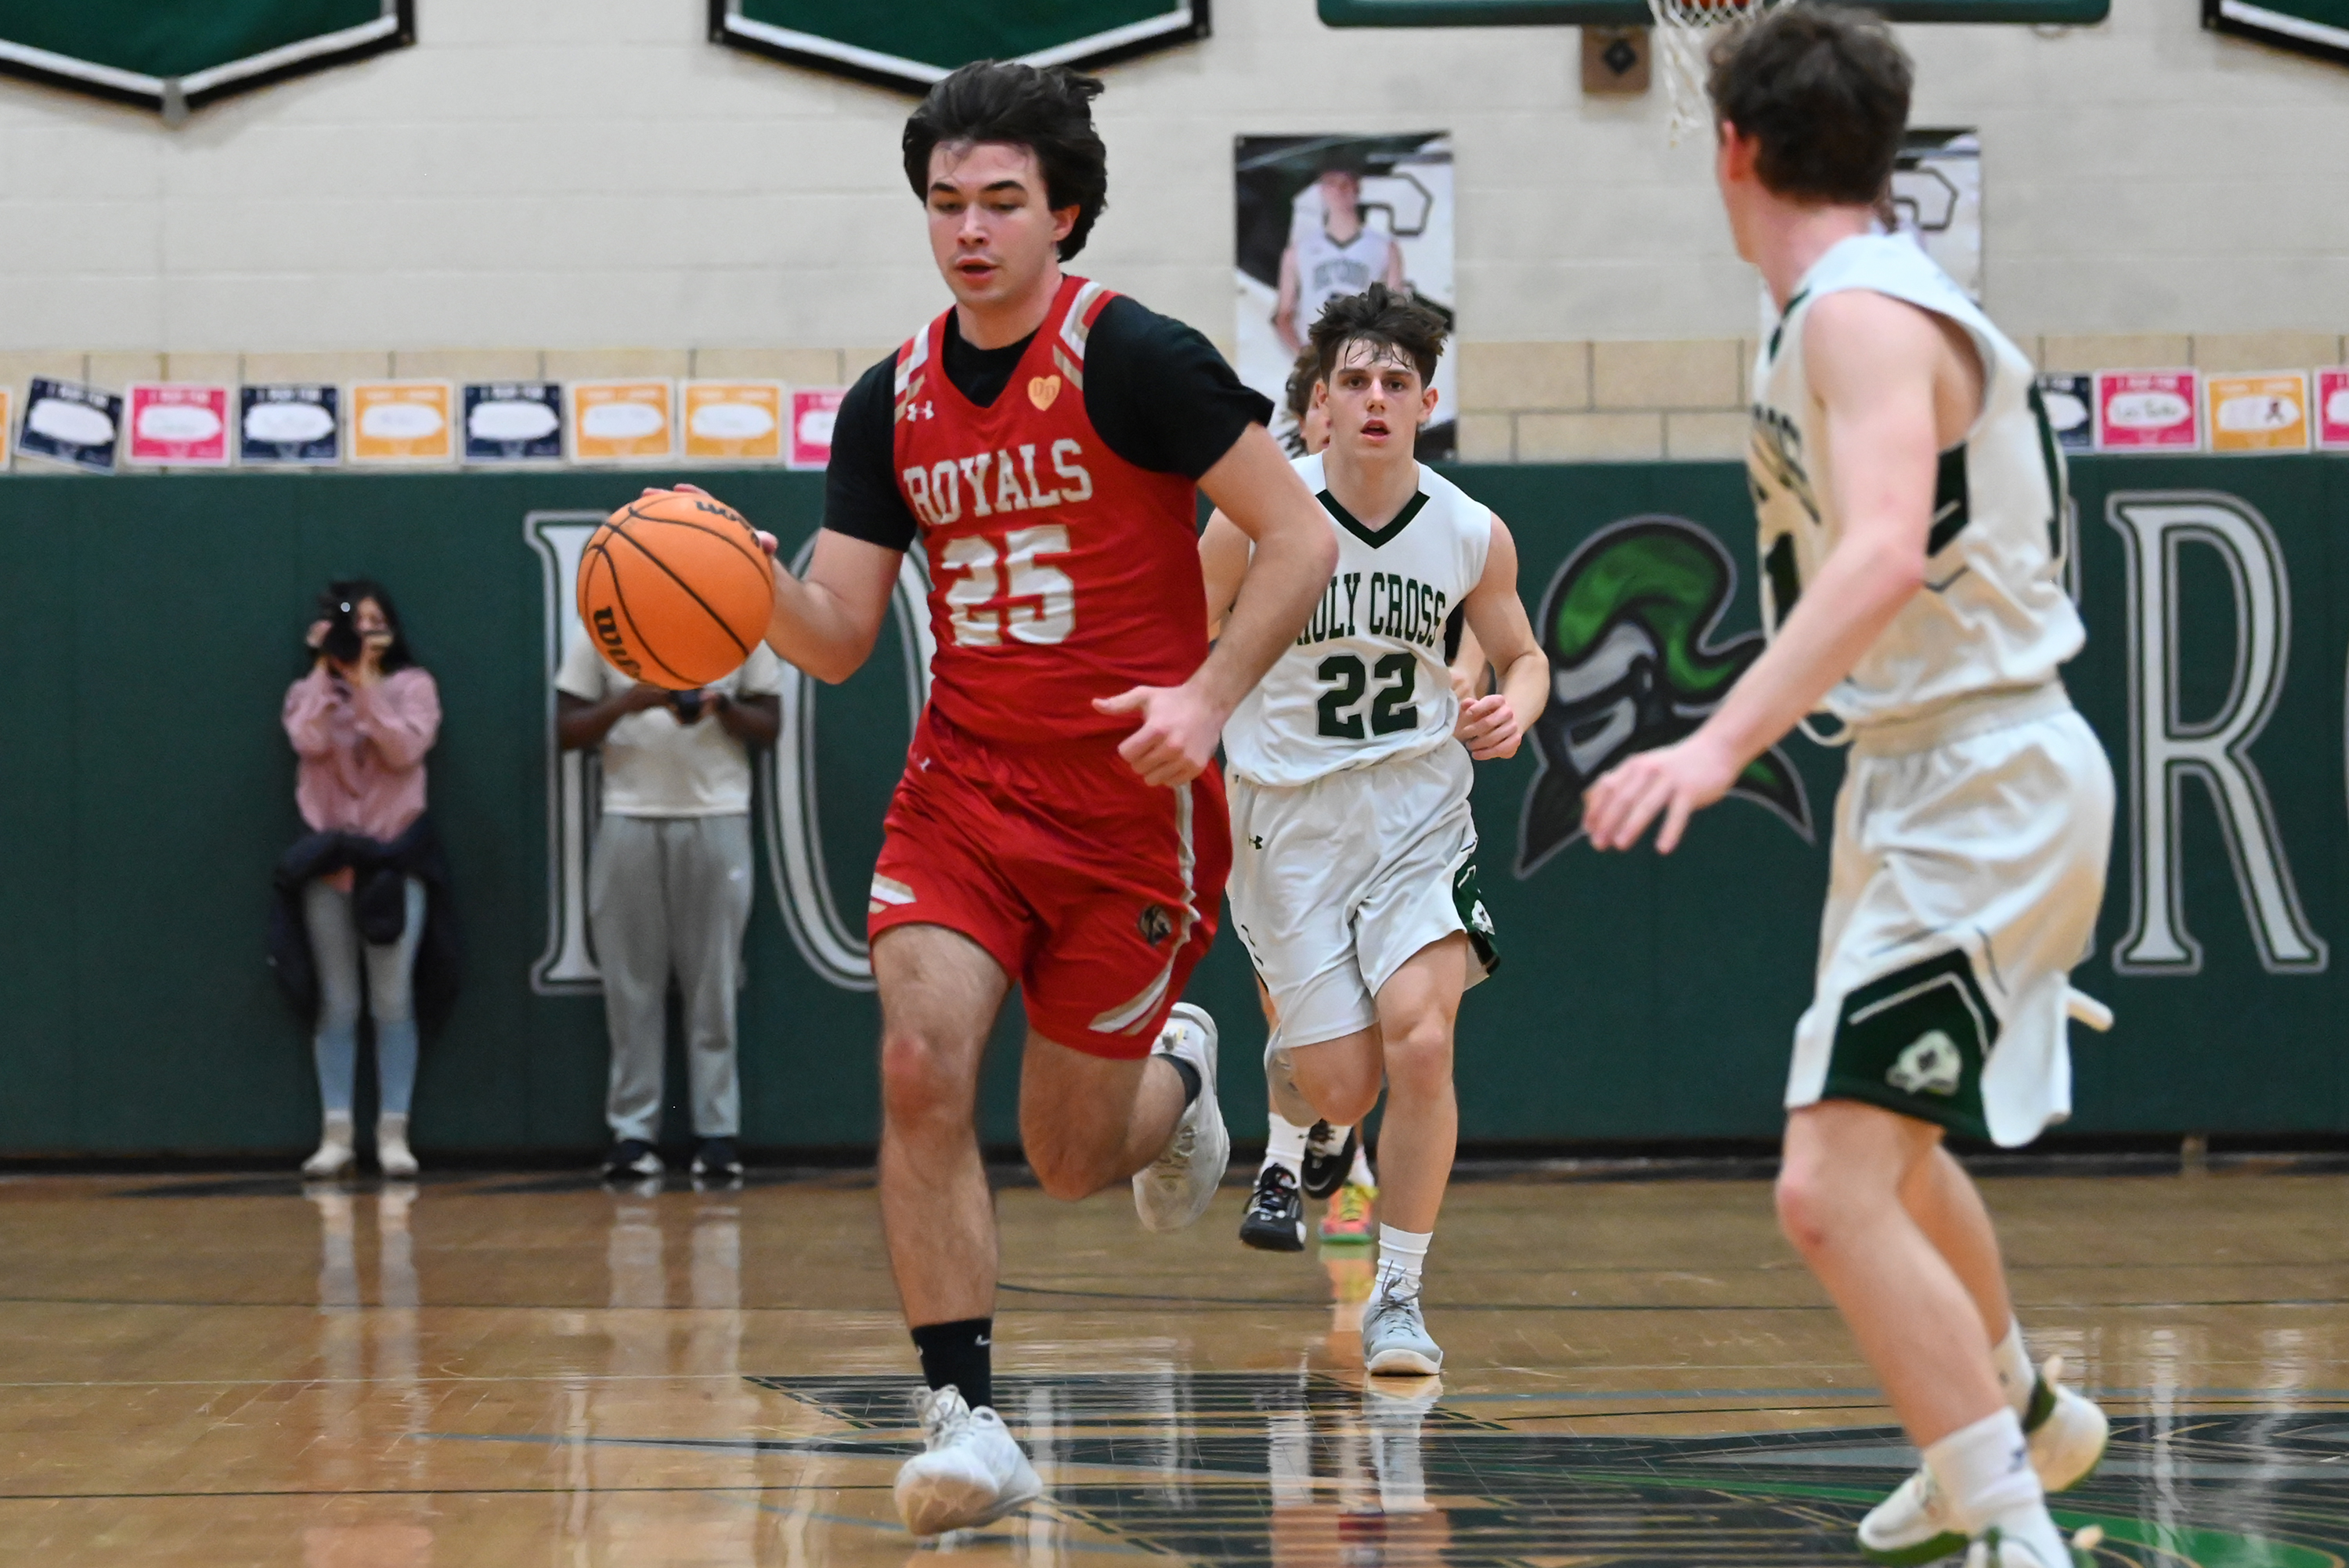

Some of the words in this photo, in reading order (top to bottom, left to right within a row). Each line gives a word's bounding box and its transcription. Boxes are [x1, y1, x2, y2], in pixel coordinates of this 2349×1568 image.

[902, 438, 1094, 525] ROYALS
[940, 524, 1077, 647] 25
[1369, 571, 1446, 648] CROSS
[1315, 652, 1418, 739] 22
